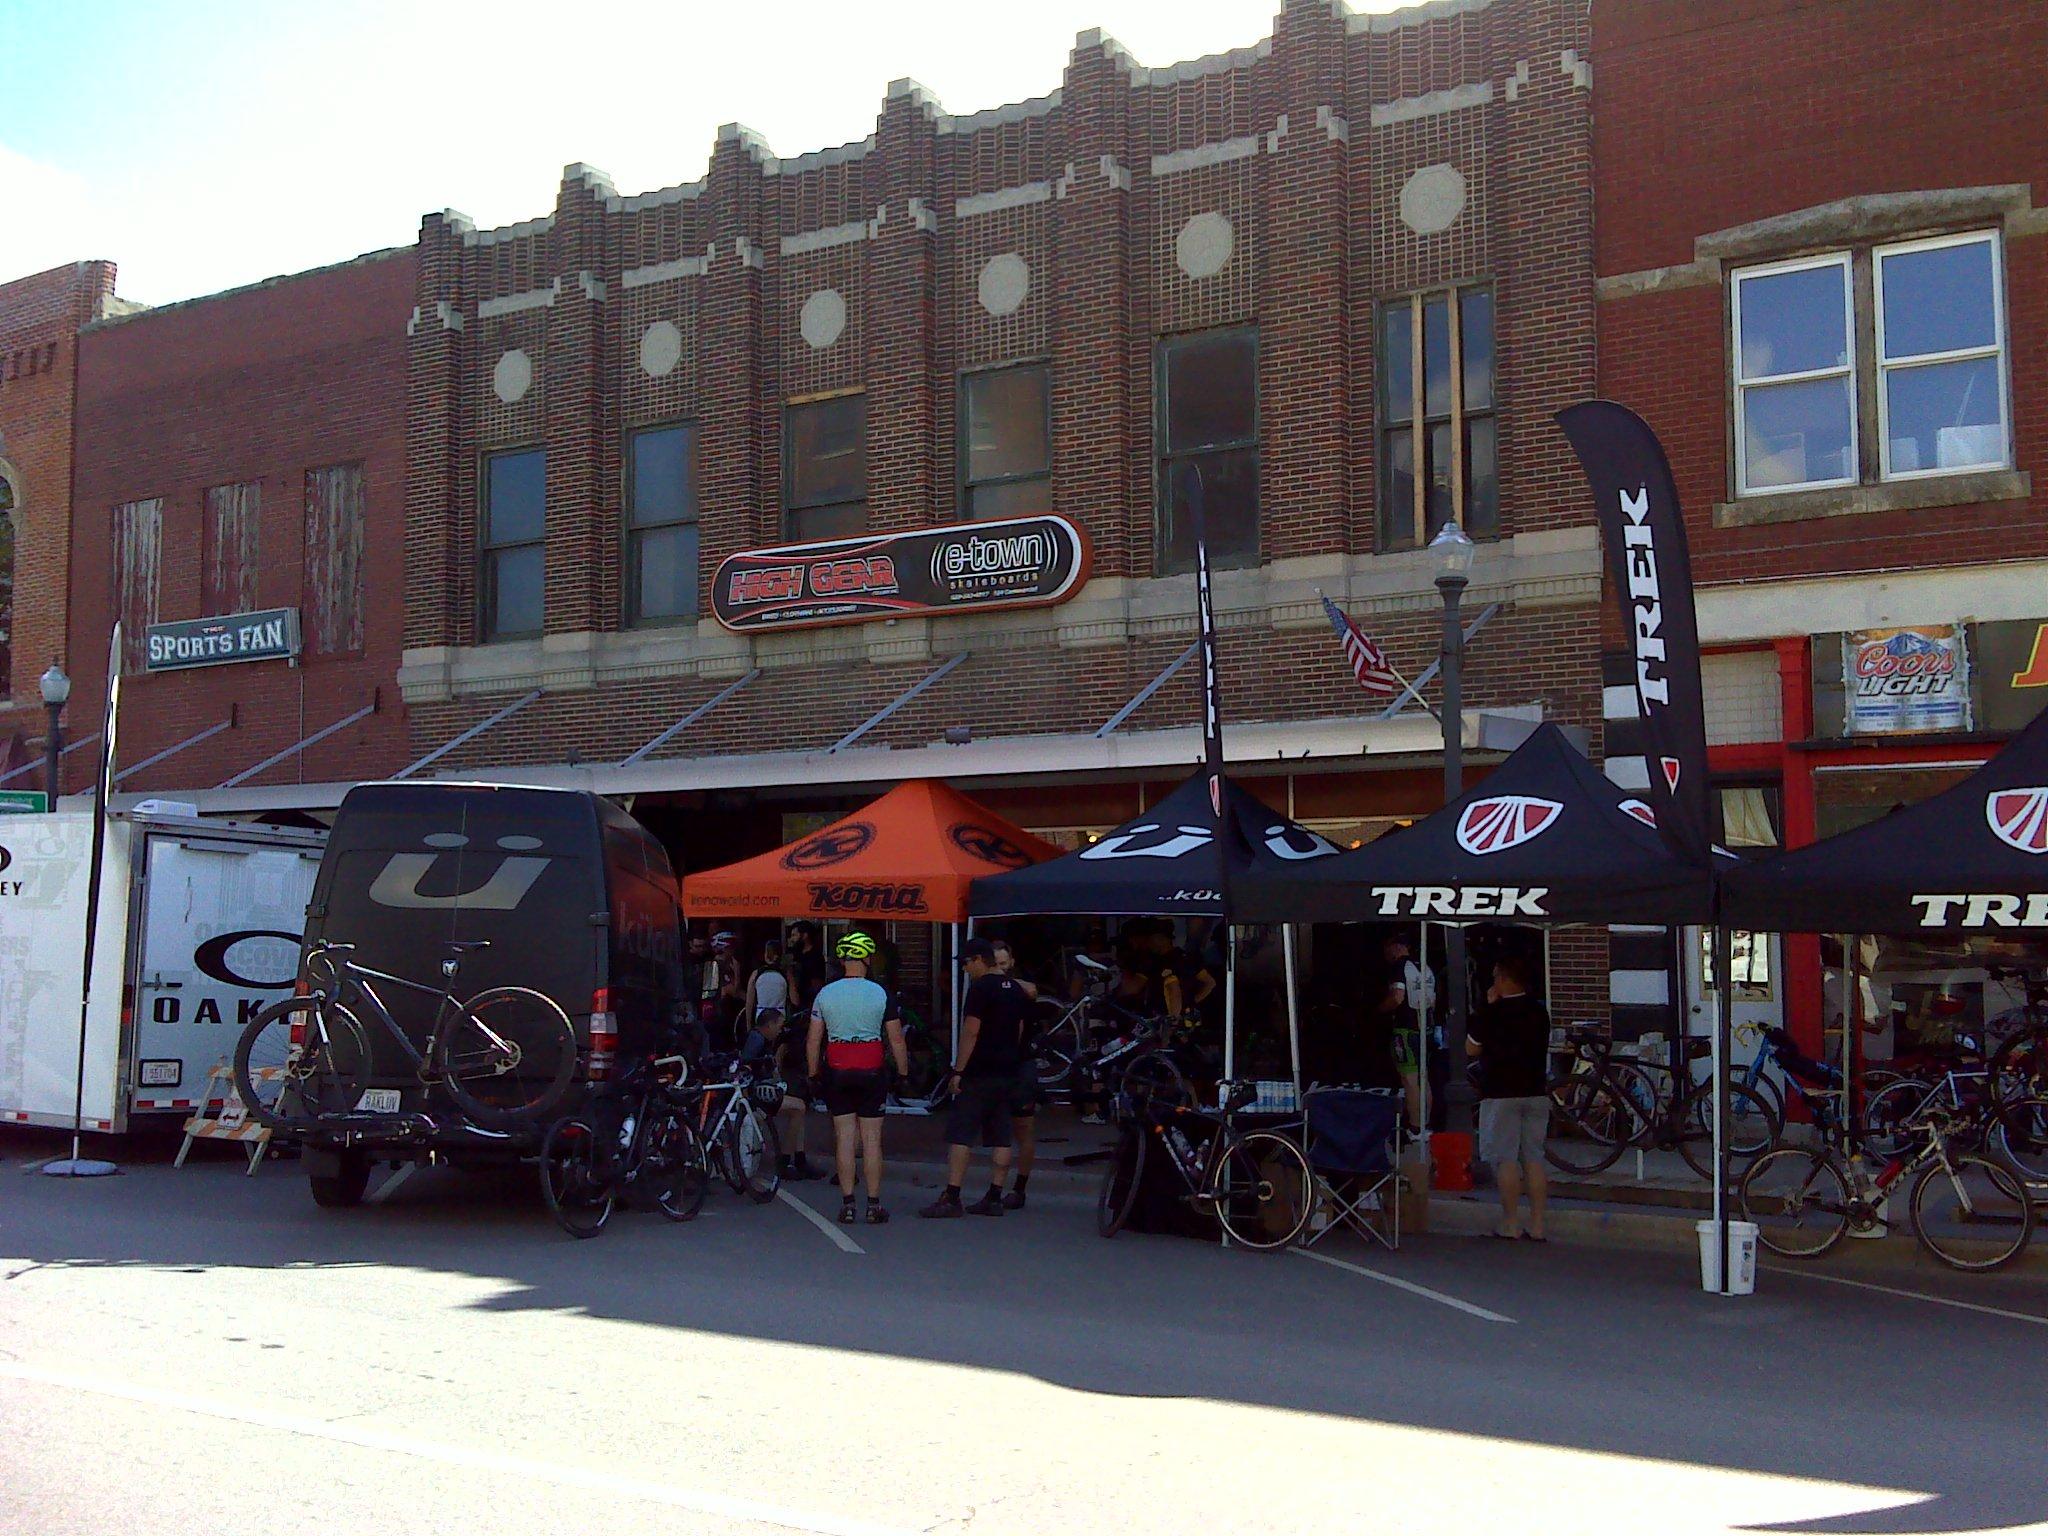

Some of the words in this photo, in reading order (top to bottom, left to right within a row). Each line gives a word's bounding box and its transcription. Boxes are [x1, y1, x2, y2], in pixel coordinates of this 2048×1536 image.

[945, 534, 1043, 574] e-town
[730, 565, 805, 605] HIGH
[810, 556, 899, 597] GEAR
[949, 571, 1039, 590] skateboards
[1619, 487, 1669, 717] TREK
[150, 633, 234, 662] SPORTS
[239, 617, 284, 651] FAN
[1856, 645, 1956, 678] Coors
[1857, 674, 1954, 696] LIGHT
[1371, 887, 1548, 915] TREK
